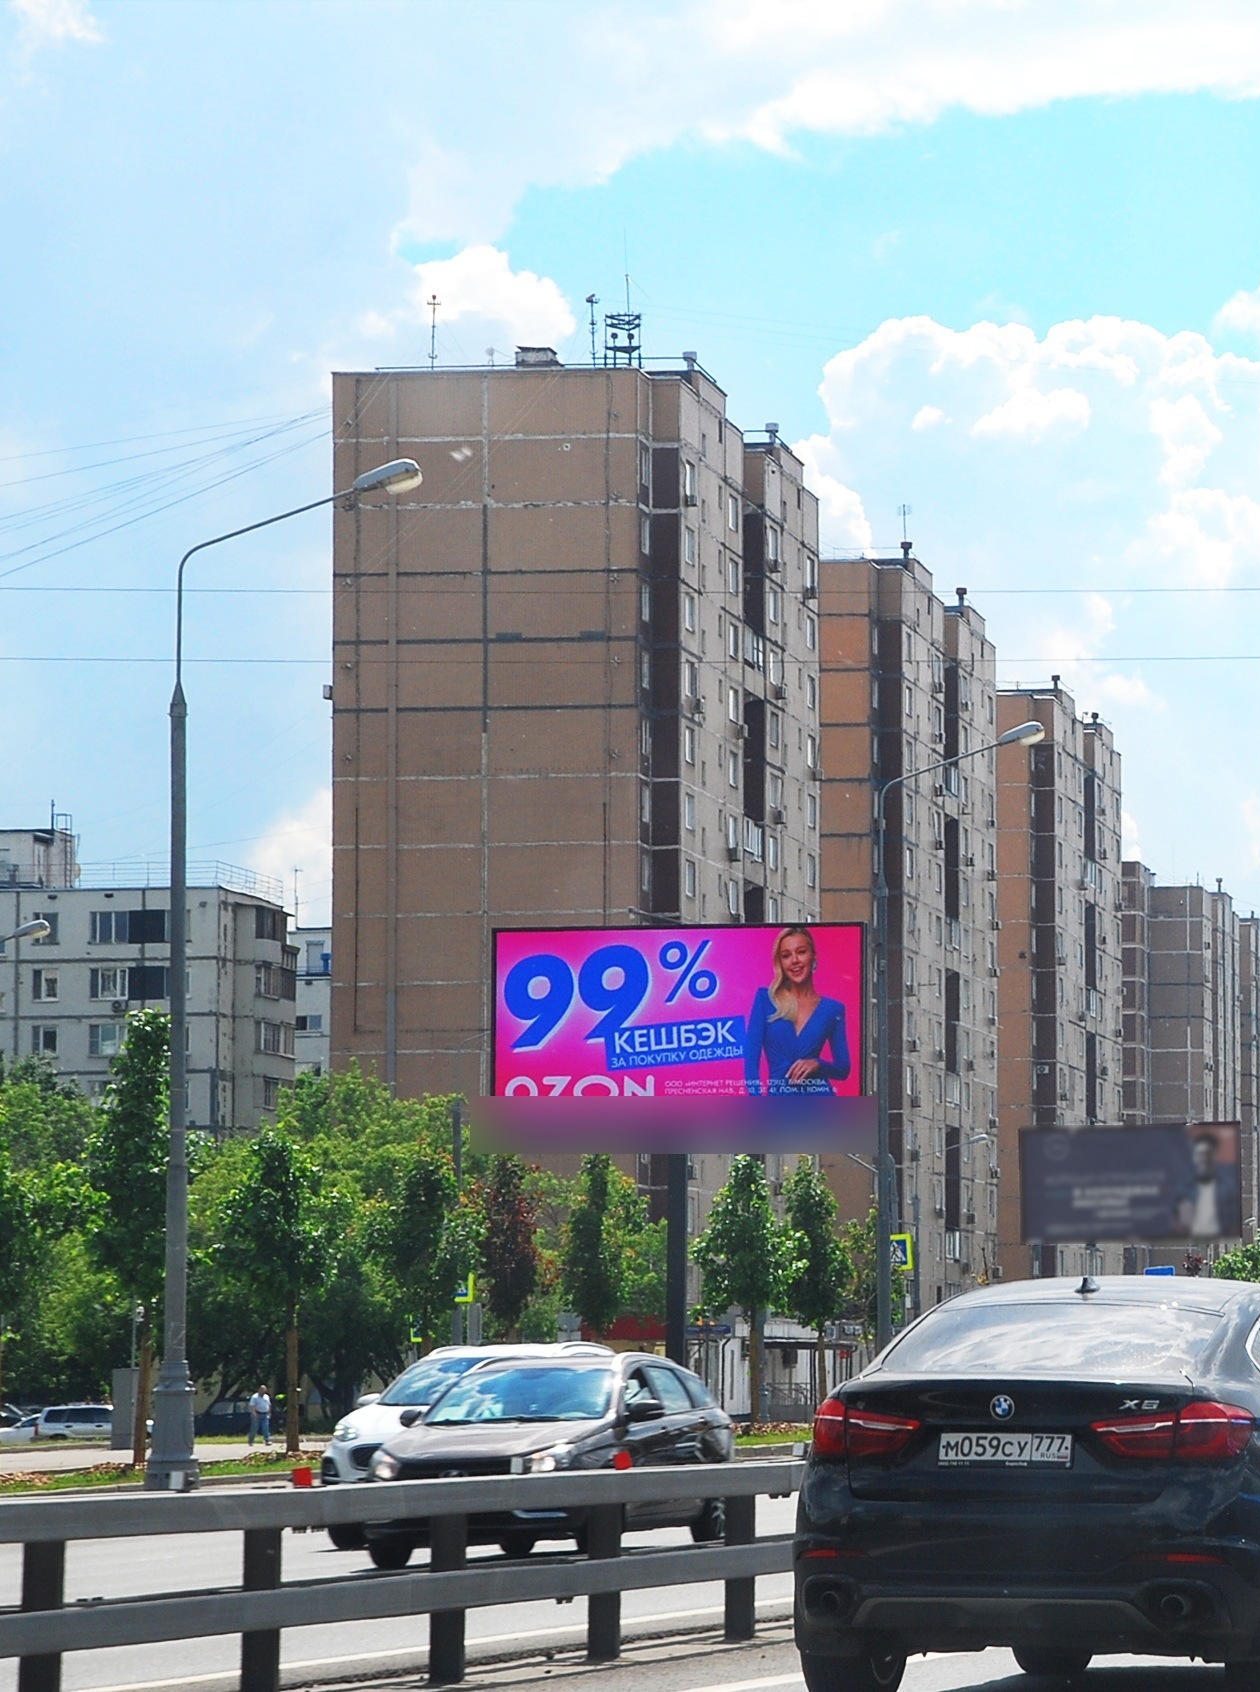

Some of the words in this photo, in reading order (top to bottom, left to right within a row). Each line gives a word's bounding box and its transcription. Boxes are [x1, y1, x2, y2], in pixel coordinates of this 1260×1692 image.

[614, 1020, 736, 1054] КЕШБЭК
[611, 1057, 627, 1068] ЗА
[629, 1051, 687, 1066] ПОКУПКУ
[688, 1045, 744, 1060] ОДЕЖДЫ
[1118, 1399, 1160, 1410] X6
[1034, 1435, 1065, 1452] 777
